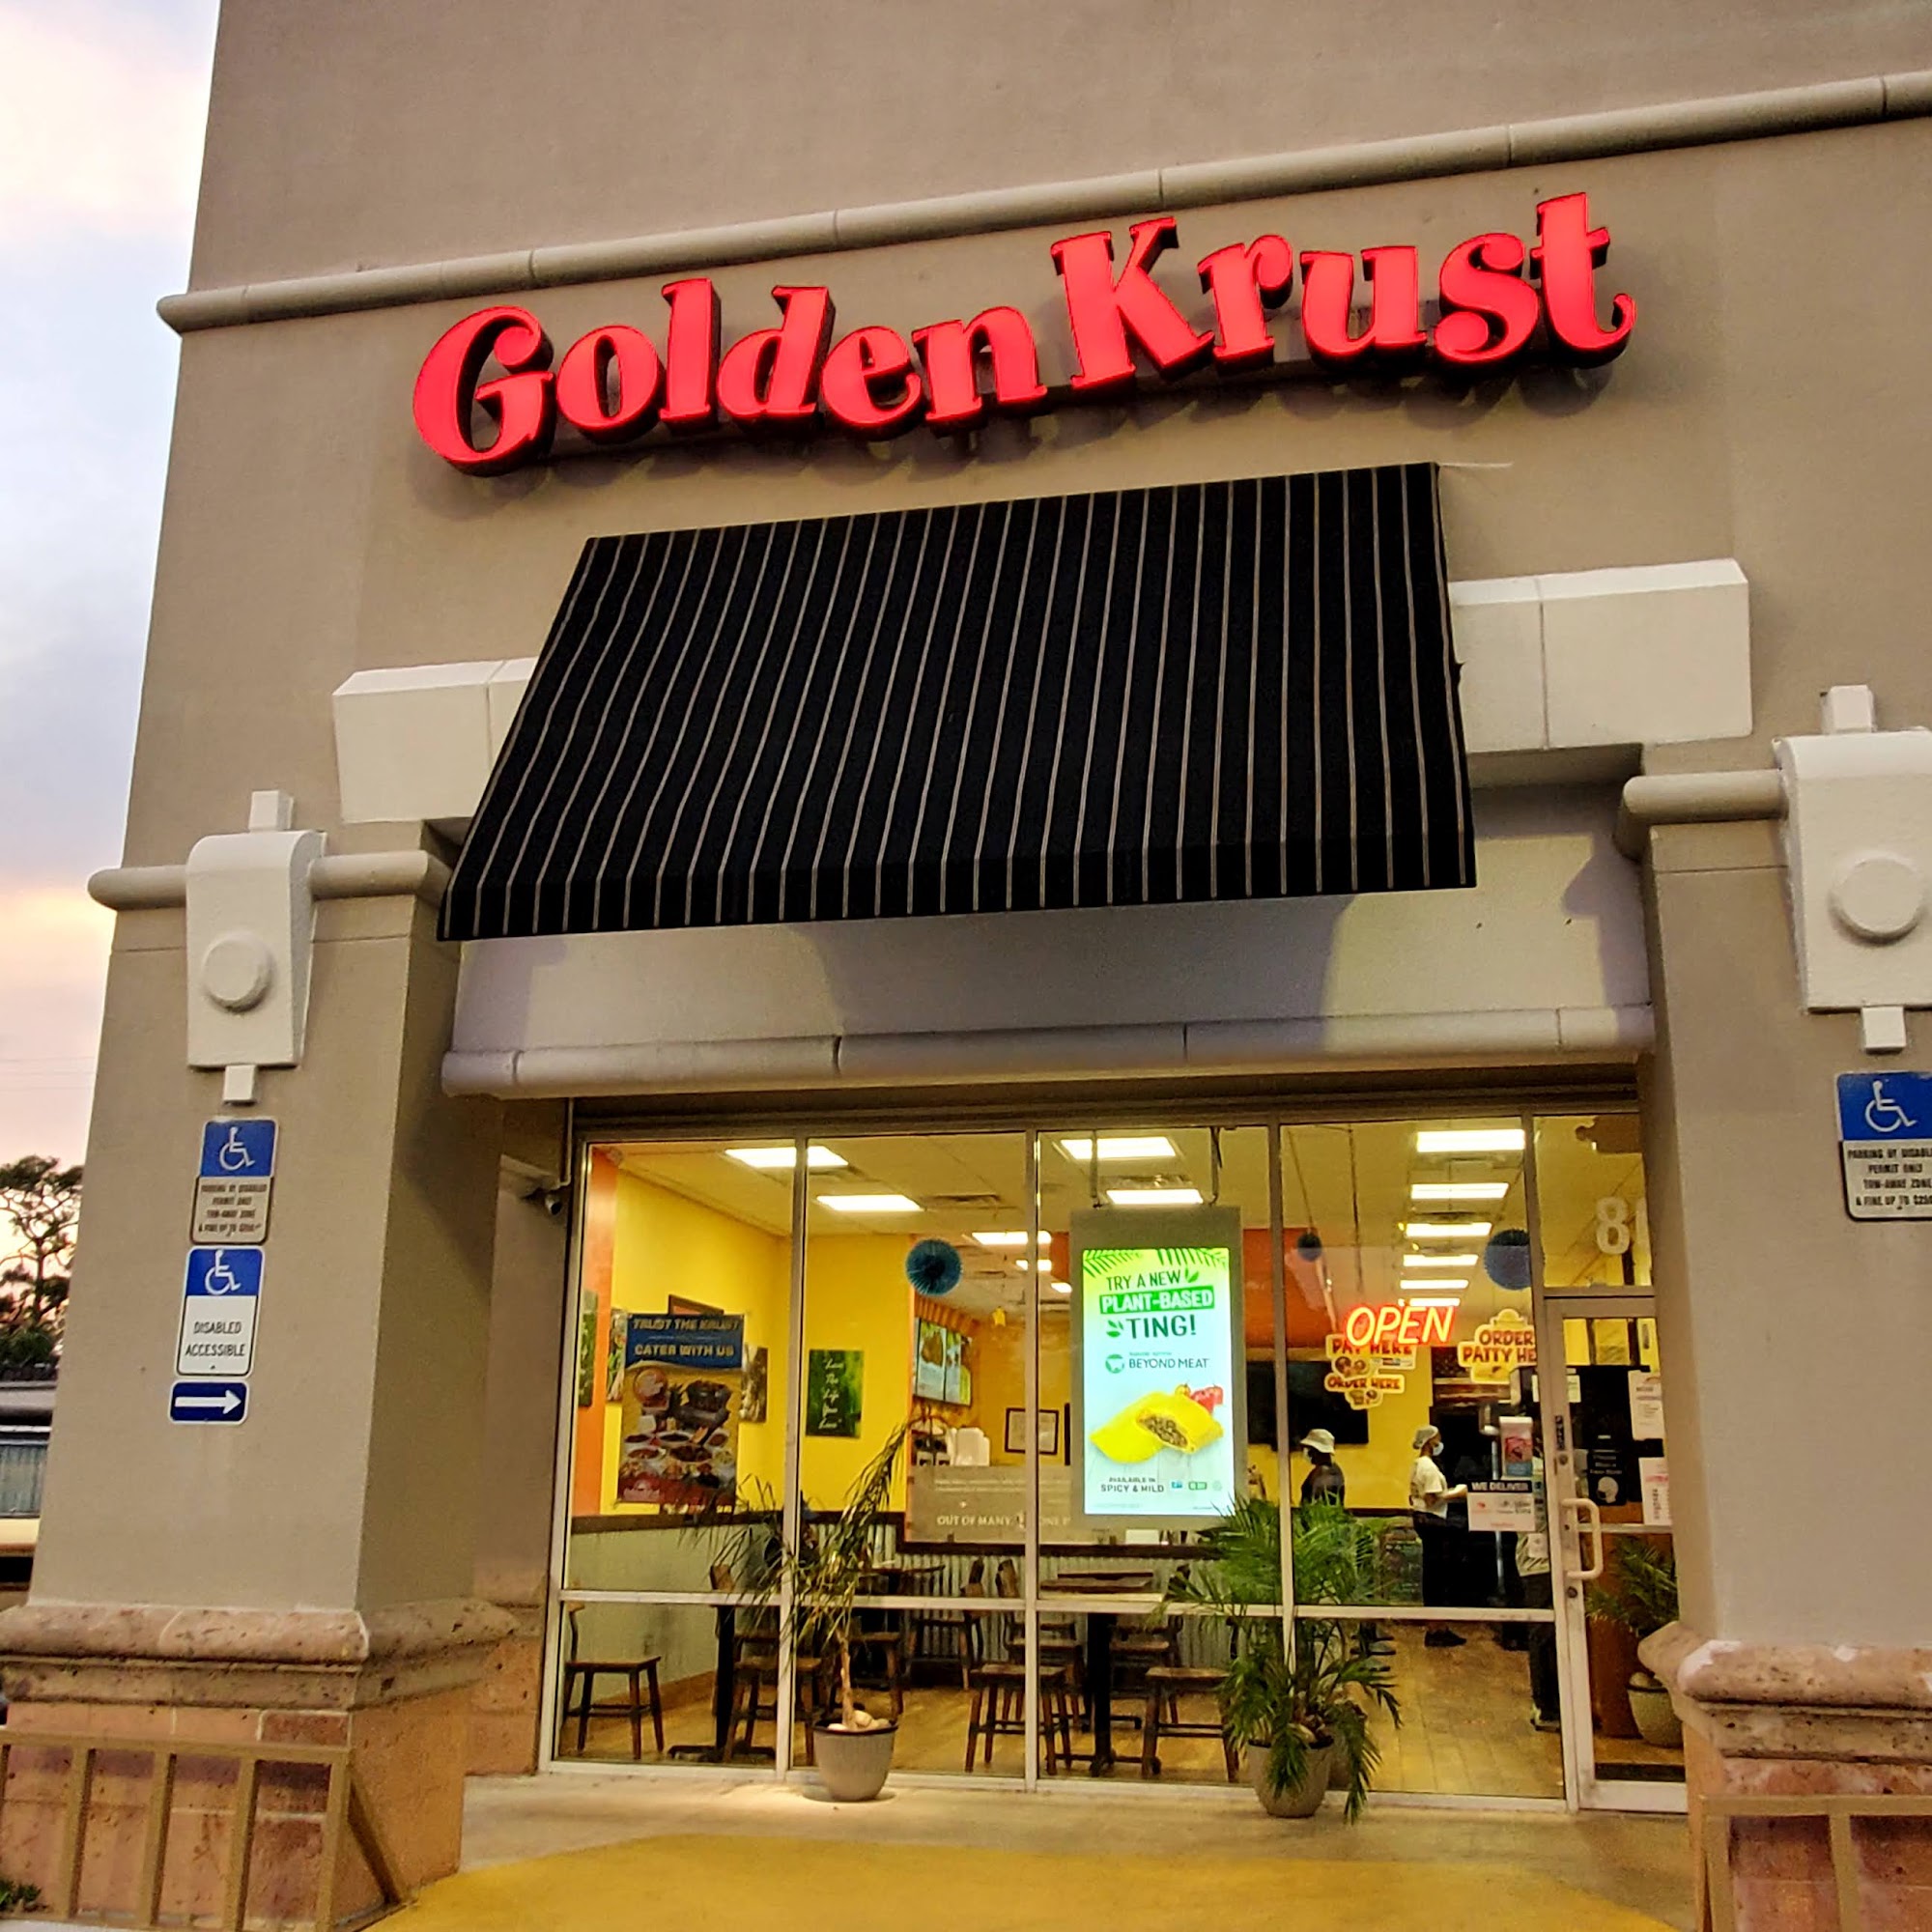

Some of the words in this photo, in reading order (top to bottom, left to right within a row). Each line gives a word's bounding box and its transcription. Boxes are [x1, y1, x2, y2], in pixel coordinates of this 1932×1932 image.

[412, 277, 1047, 469] Golden
[1050, 192, 1636, 389] Krust
[1106, 1275, 1131, 1291] TRY
[1137, 1273, 1146, 1288] A
[1150, 1269, 1180, 1287] NEW
[1102, 1289, 1213, 1313] PLANT-BASED
[194, 1321, 242, 1334] DISABLED
[1125, 1314, 1196, 1339] TING!
[1347, 1306, 1453, 1346] OPEN
[1479, 1329, 1533, 1346] ORDER
[185, 1343, 246, 1357] ACCESSIBLE
[635, 1344, 676, 1356] CATER
[680, 1344, 713, 1356] WITH
[716, 1344, 734, 1356] US
[1463, 1347, 1513, 1363] PATTY
[1128, 1358, 1176, 1369] BEYOND
[1178, 1358, 1209, 1369] MEAT
[1100, 1484, 1129, 1492] SPICY
[1132, 1484, 1139, 1492] &
[1141, 1484, 1164, 1492] MILD
[936, 1515, 960, 1525] OUT
